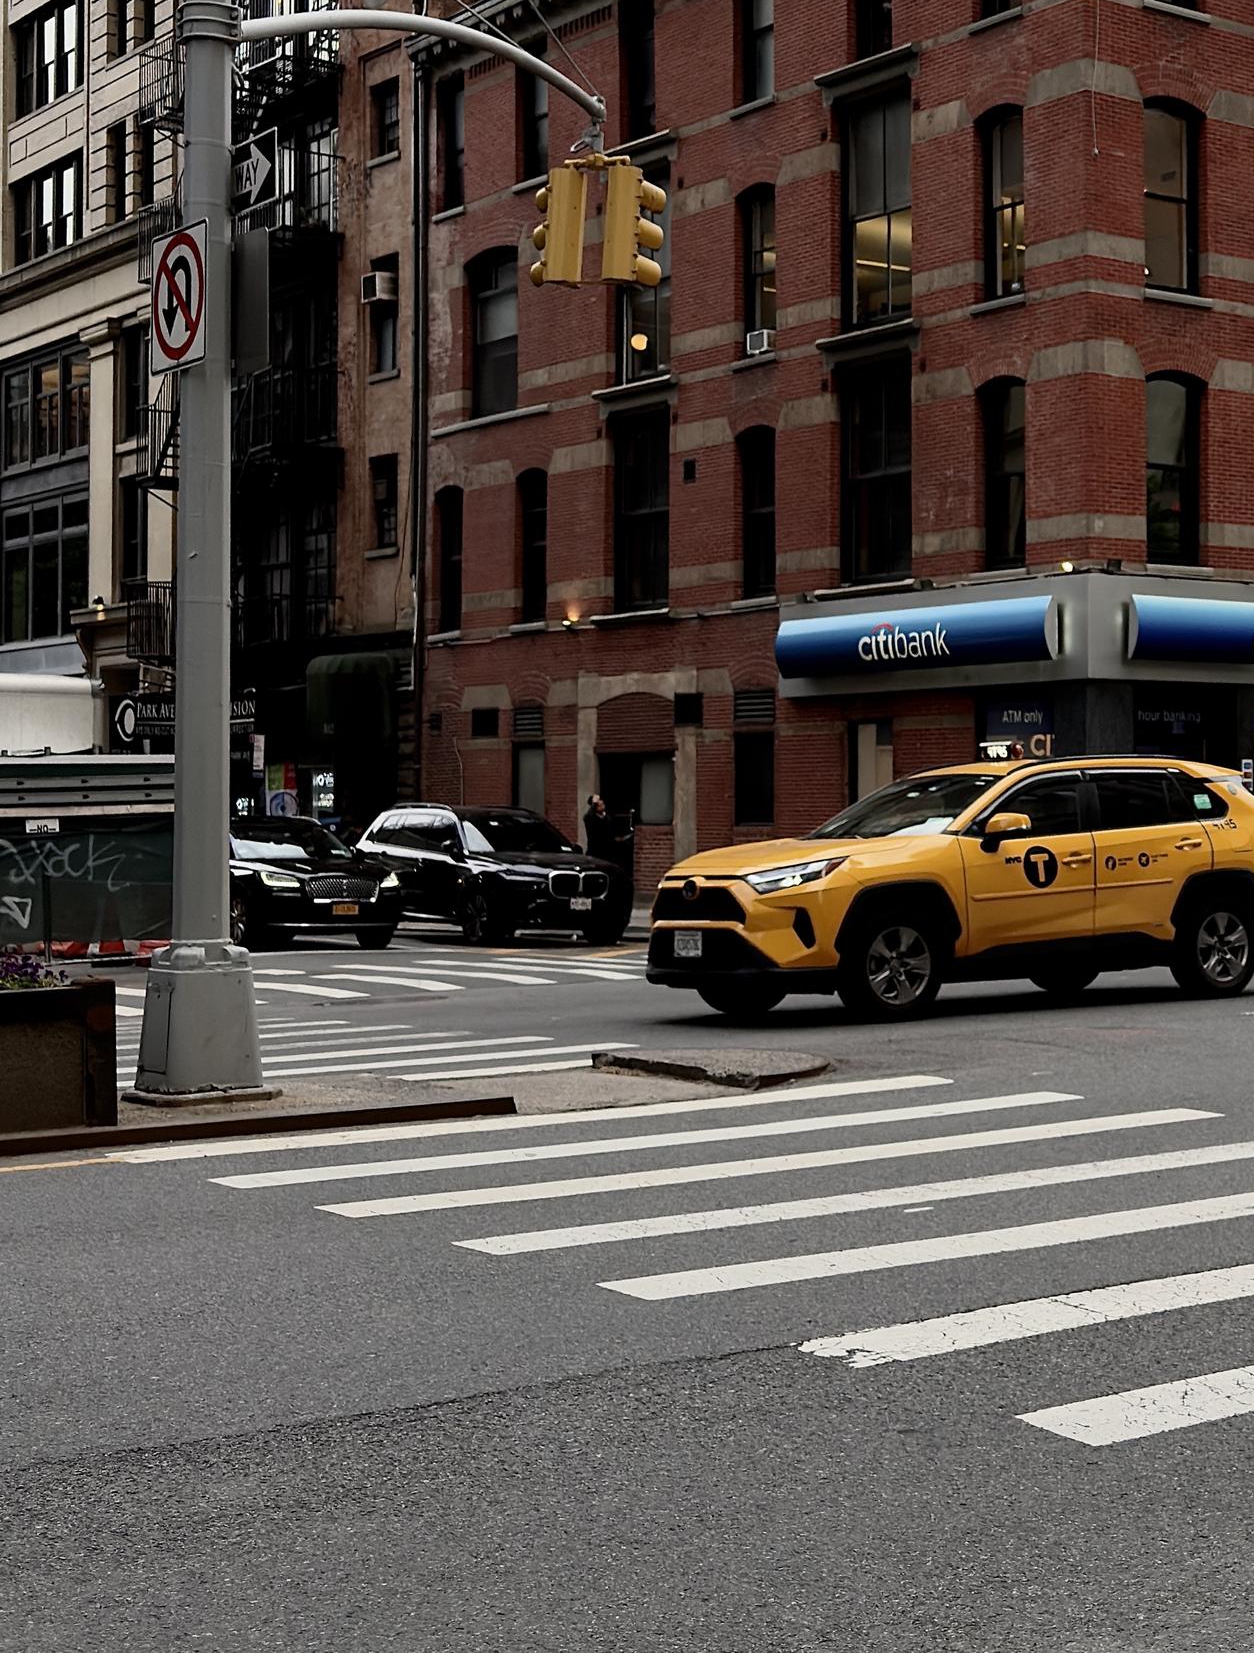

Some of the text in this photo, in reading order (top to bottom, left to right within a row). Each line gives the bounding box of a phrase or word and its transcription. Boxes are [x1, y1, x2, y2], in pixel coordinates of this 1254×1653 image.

[234, 158, 259, 193] WAY
[858, 621, 951, 662] citibank
[1002, 709, 1044, 725] ATM only
